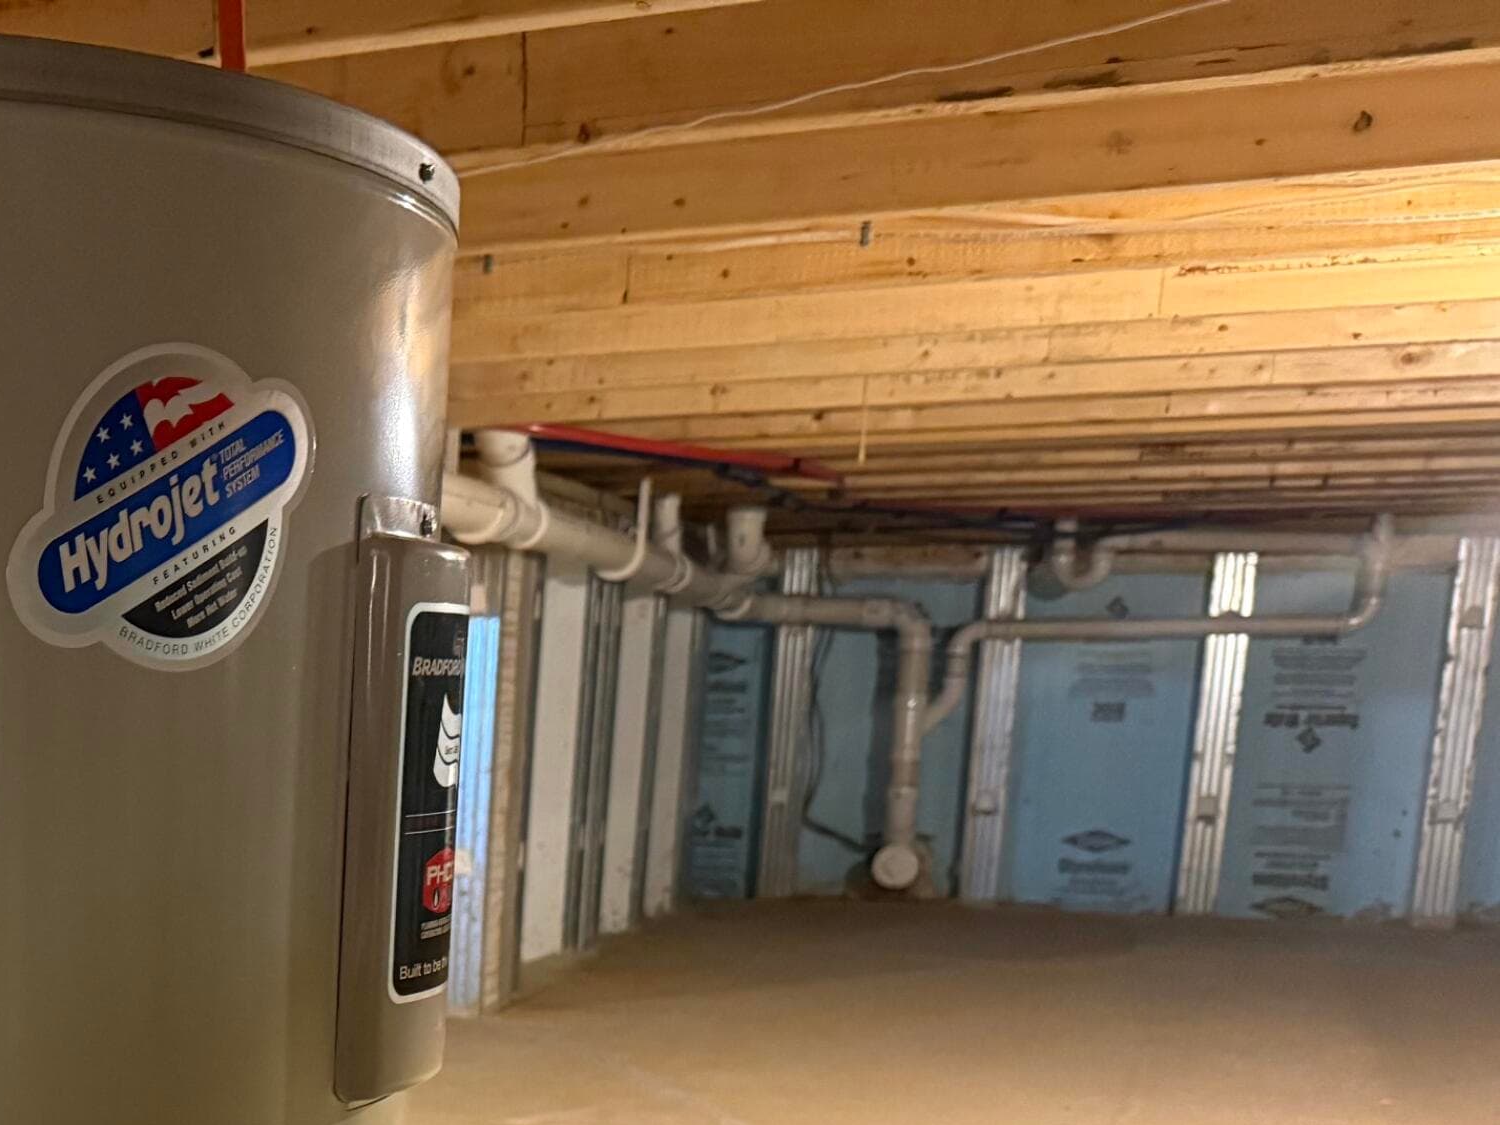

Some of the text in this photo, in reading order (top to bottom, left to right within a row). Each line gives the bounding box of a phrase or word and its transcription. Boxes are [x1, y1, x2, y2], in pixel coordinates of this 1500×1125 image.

[96, 420, 226, 504] EQUIPPED WITH
[218, 438, 247, 464] TOTAL
[222, 428, 284, 480] PERFORMANCE
[225, 463, 260, 498] SYSTEM
[58, 456, 220, 593] Hydrojet
[152, 526, 237, 586] FEATURING
[118, 526, 278, 656] BRADFORD WHITE CORPORATION
[399, 962, 422, 980] Built
[423, 961, 432, 976] to
